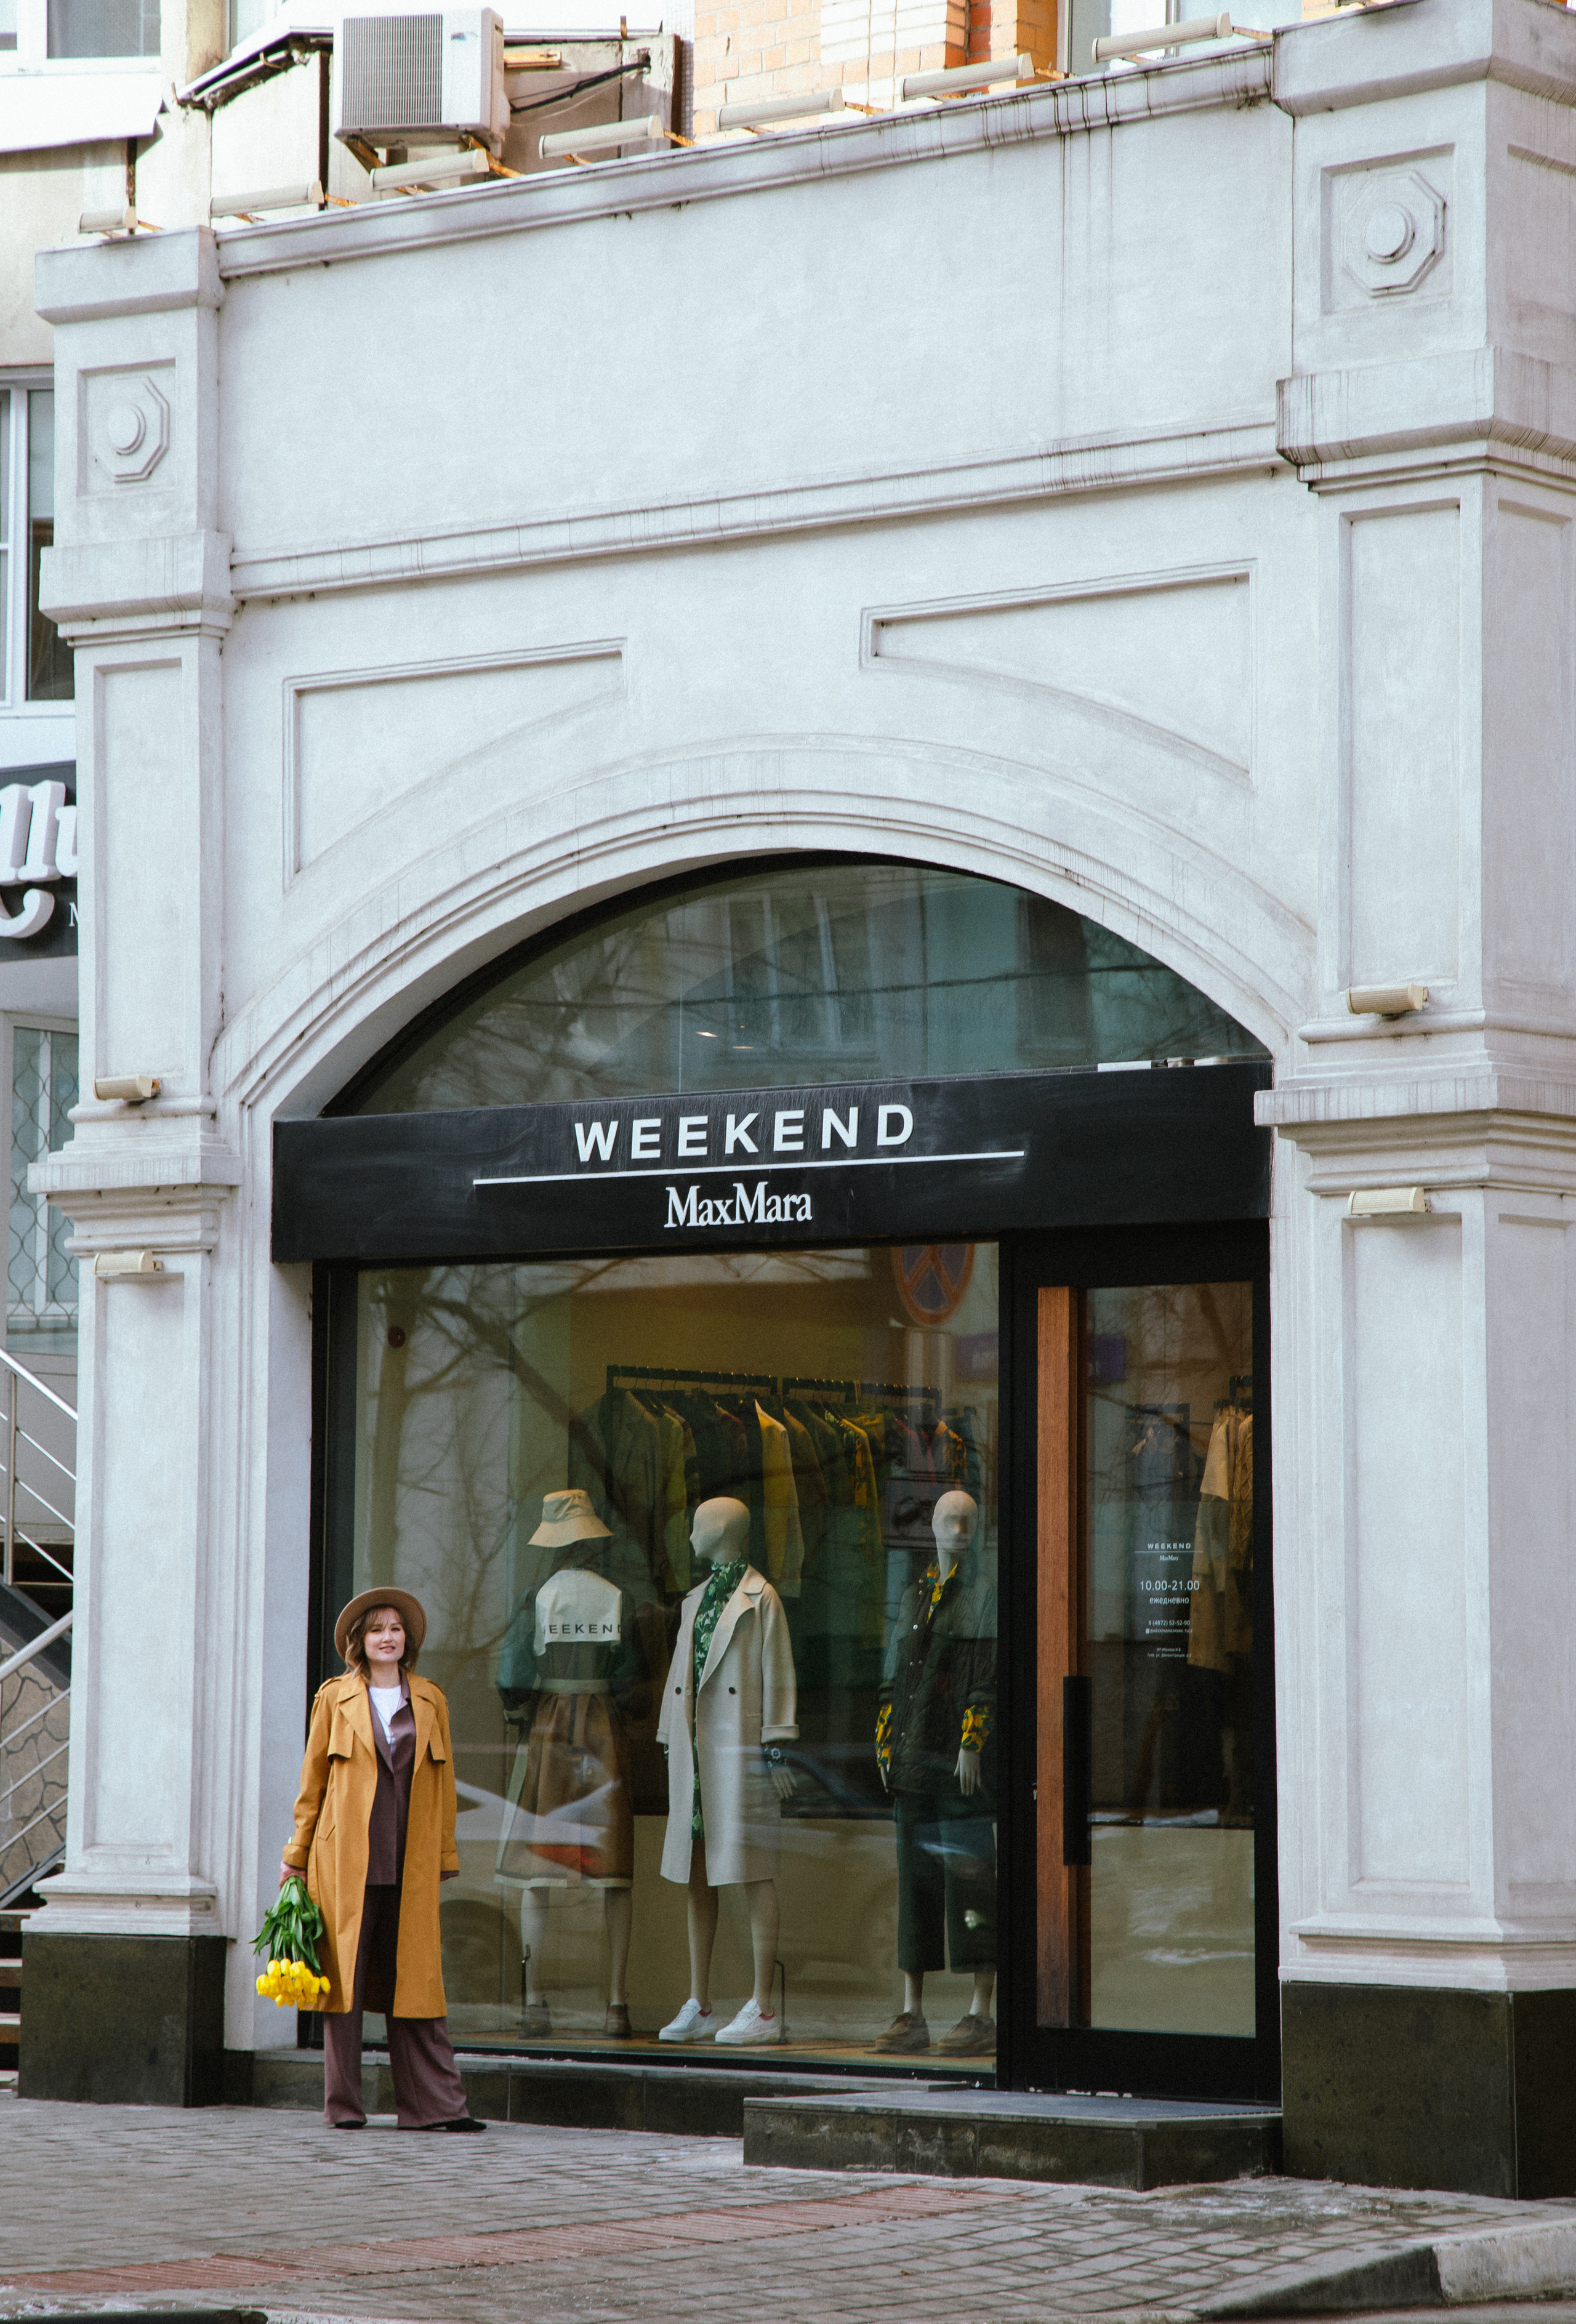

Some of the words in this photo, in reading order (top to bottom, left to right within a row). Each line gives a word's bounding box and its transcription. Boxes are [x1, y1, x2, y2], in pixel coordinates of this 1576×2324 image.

[574, 1104, 914, 1162] WEEKEND
[664, 1181, 813, 1228] MaxMara
[1149, 1597, 1189, 1605] ежедневно
[544, 1624, 621, 1634] EEKEN
